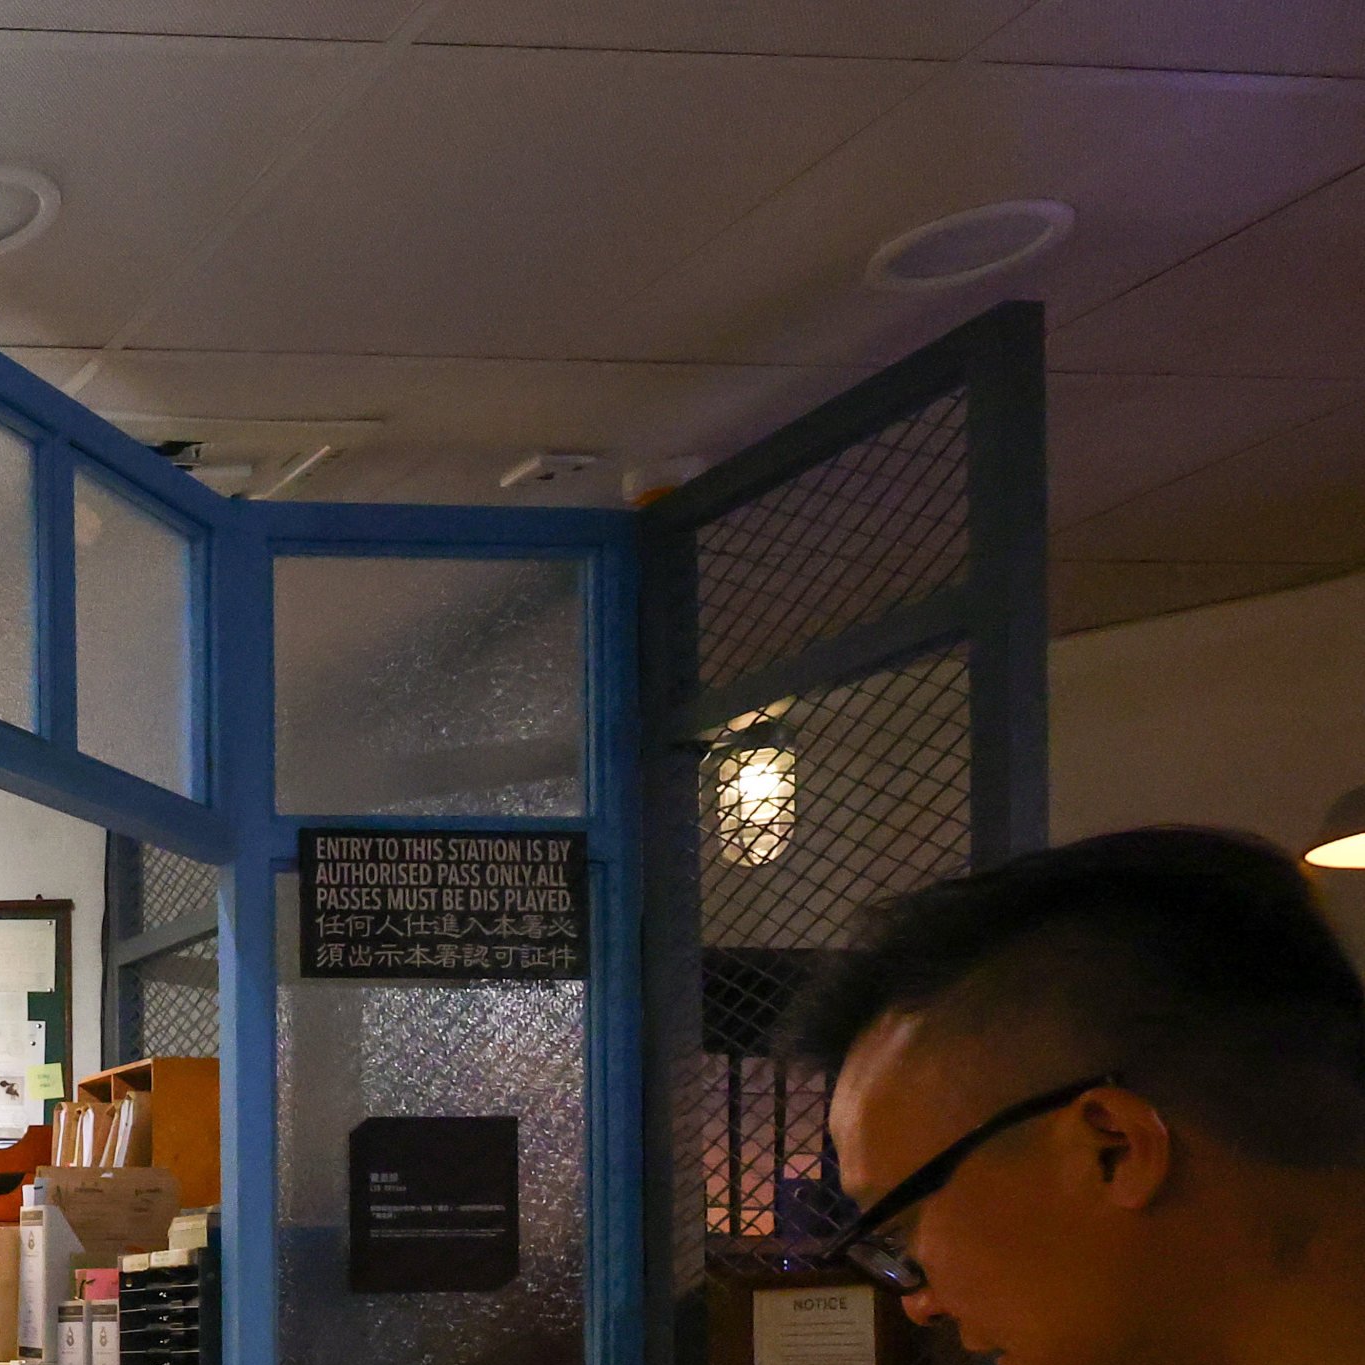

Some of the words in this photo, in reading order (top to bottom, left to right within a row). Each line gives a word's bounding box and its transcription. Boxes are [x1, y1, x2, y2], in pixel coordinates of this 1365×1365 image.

[316, 837, 376, 860] ENTRY
[377, 838, 399, 861] TO
[403, 838, 442, 861] THIS
[449, 838, 521, 861] STATION
[526, 839, 542, 862] IS
[548, 840, 571, 862] BY
[315, 862, 431, 885] AUTHORISED
[437, 864, 481, 886] PASS
[316, 888, 381, 910] PASSES
[387, 889, 438, 911] MUST
[442, 889, 463, 910] BE
[315, 912, 578, 938] 任何人仕進入本署必
[316, 943, 577, 969] 須出示本署認可証件
[793, 1297, 847, 1311] NOTICE
